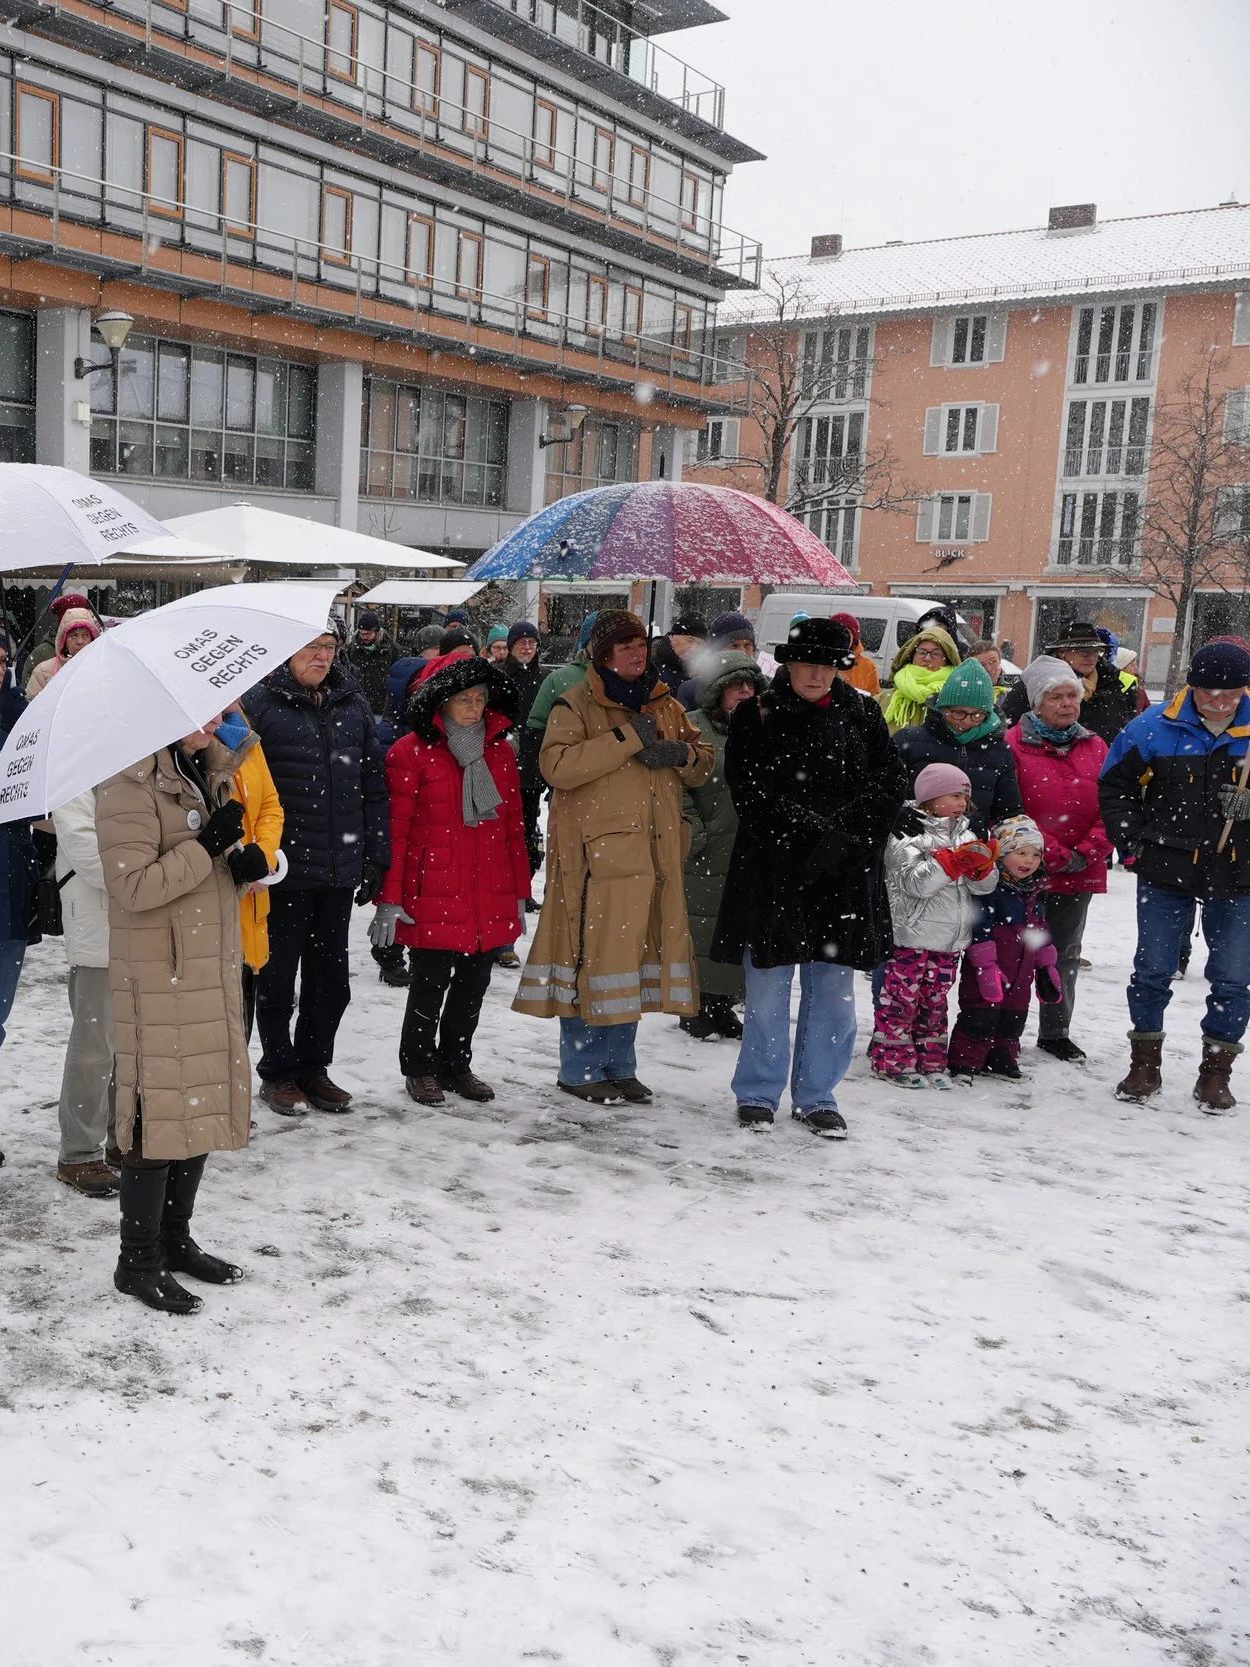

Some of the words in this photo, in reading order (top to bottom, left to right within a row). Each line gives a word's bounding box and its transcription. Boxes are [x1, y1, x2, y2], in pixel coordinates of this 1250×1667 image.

[71, 494, 103, 509] OMAS
[85, 507, 123, 525] GEGEN
[99, 522, 139, 542] RECHTS
[934, 549, 967, 558] BLICK
[173, 629, 219, 660] OMAS
[190, 634, 244, 673] GEGEN
[207, 644, 268, 689] RECHTS
[16, 728, 41, 751] OMAS
[6, 753, 35, 778] GEGEN
[0, 780, 30, 805] RECHTS
